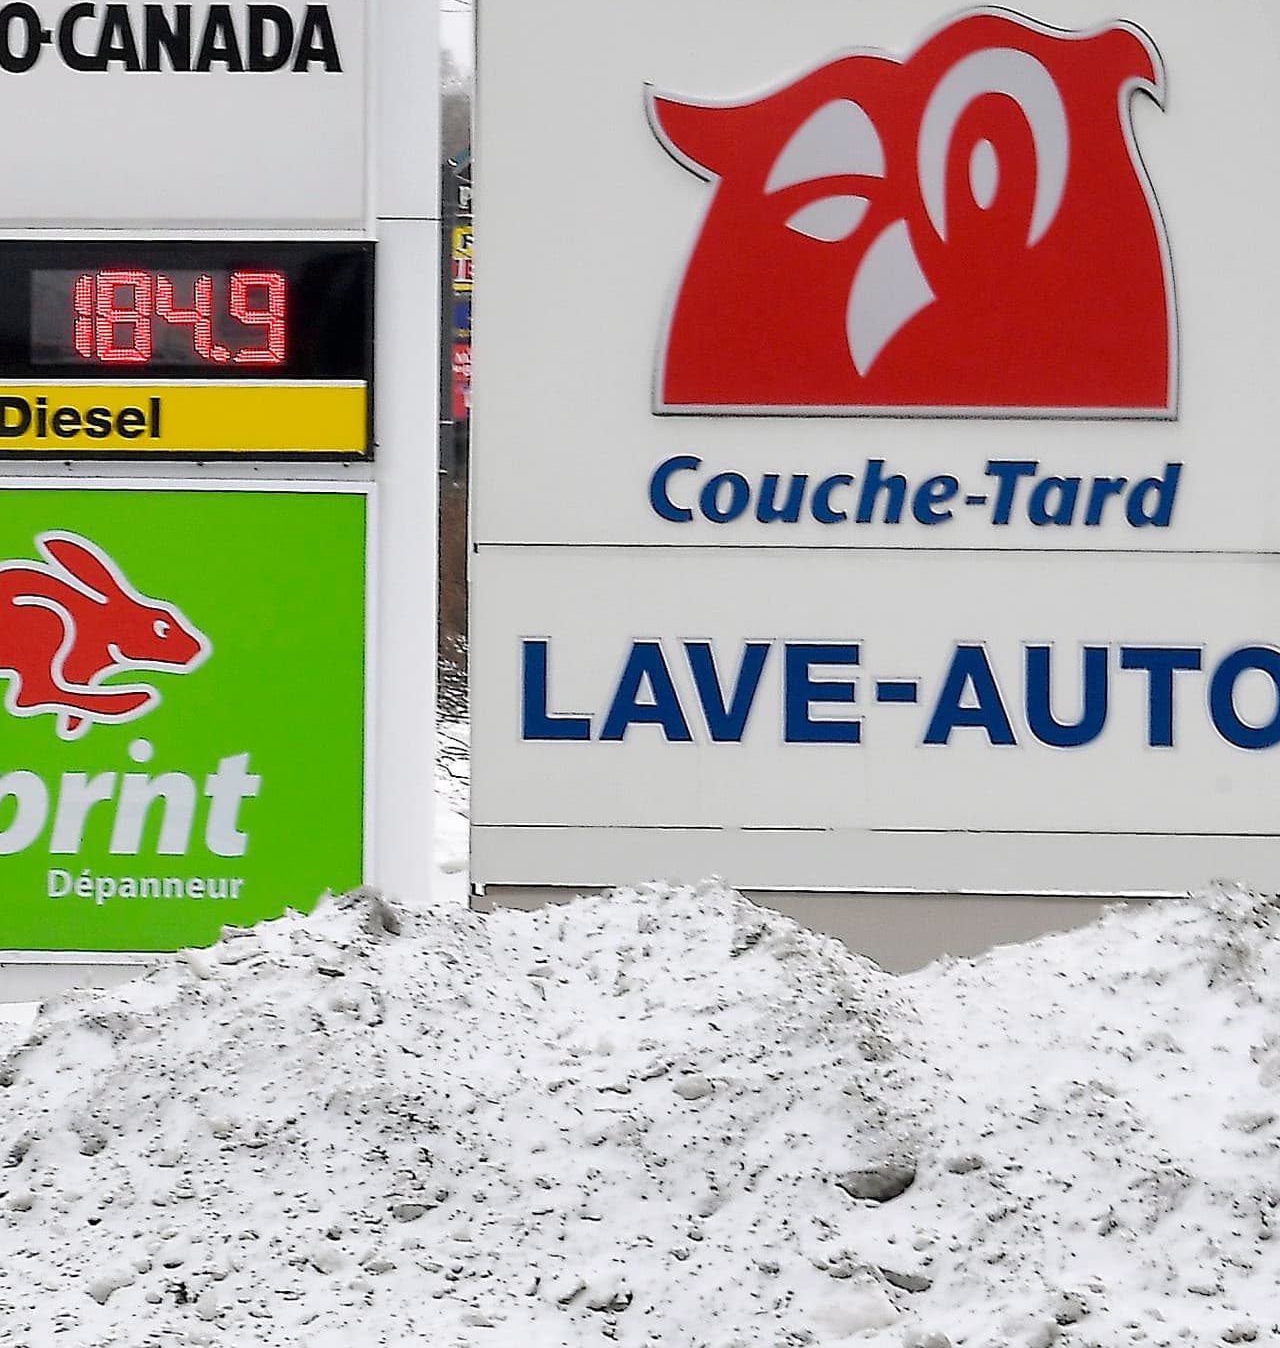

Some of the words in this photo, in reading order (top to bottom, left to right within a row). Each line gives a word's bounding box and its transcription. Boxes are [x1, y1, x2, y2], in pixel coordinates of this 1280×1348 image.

[73, 268, 288, 364] 184.9
[649, 455, 1185, 528] Couche-Tard
[45, 868, 245, 905] Dépanneur
